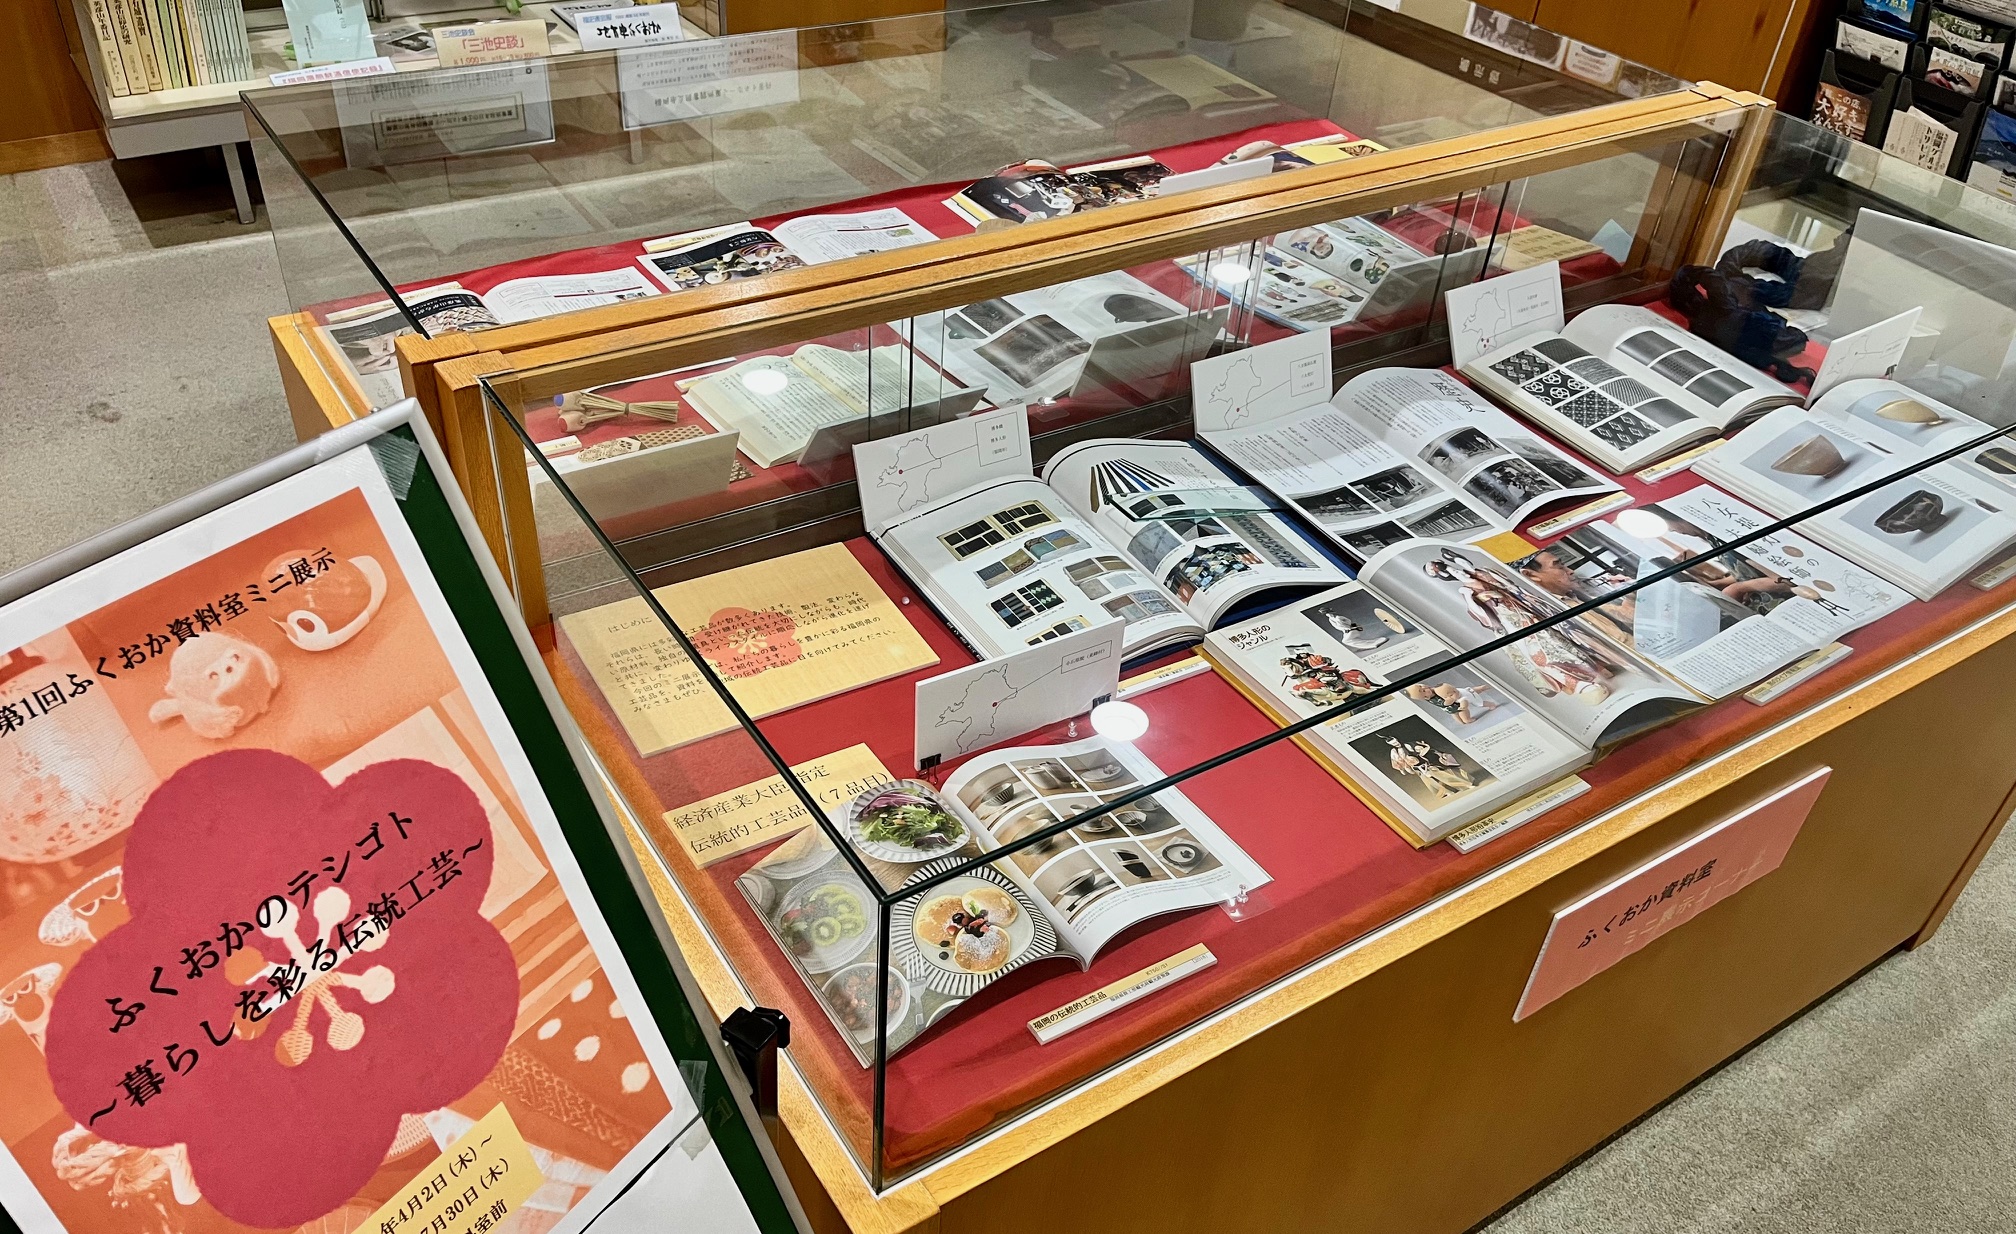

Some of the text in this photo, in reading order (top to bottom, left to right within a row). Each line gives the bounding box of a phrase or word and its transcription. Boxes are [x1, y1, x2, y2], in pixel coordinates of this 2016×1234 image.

[462, 35, 525, 53] 「三池史談」
[0, 547, 337, 738] 第1回ふくおか資料室ミニ展示
[608, 616, 653, 634] はじめに
[1228, 624, 1271, 644] 博多人形の
[1237, 634, 1269, 650] ジャンル
[619, 673, 672, 691] てきました。
[673, 765, 831, 830] 経済産業大臣指定
[1577, 858, 1718, 950] ふくおか資料室
[1623, 851, 1764, 946] ミニ展示コーナー
[105, 811, 415, 1034] ふくおかのテシゴト
[1033, 991, 1107, 1030] 福岡の伝統的工芸品
